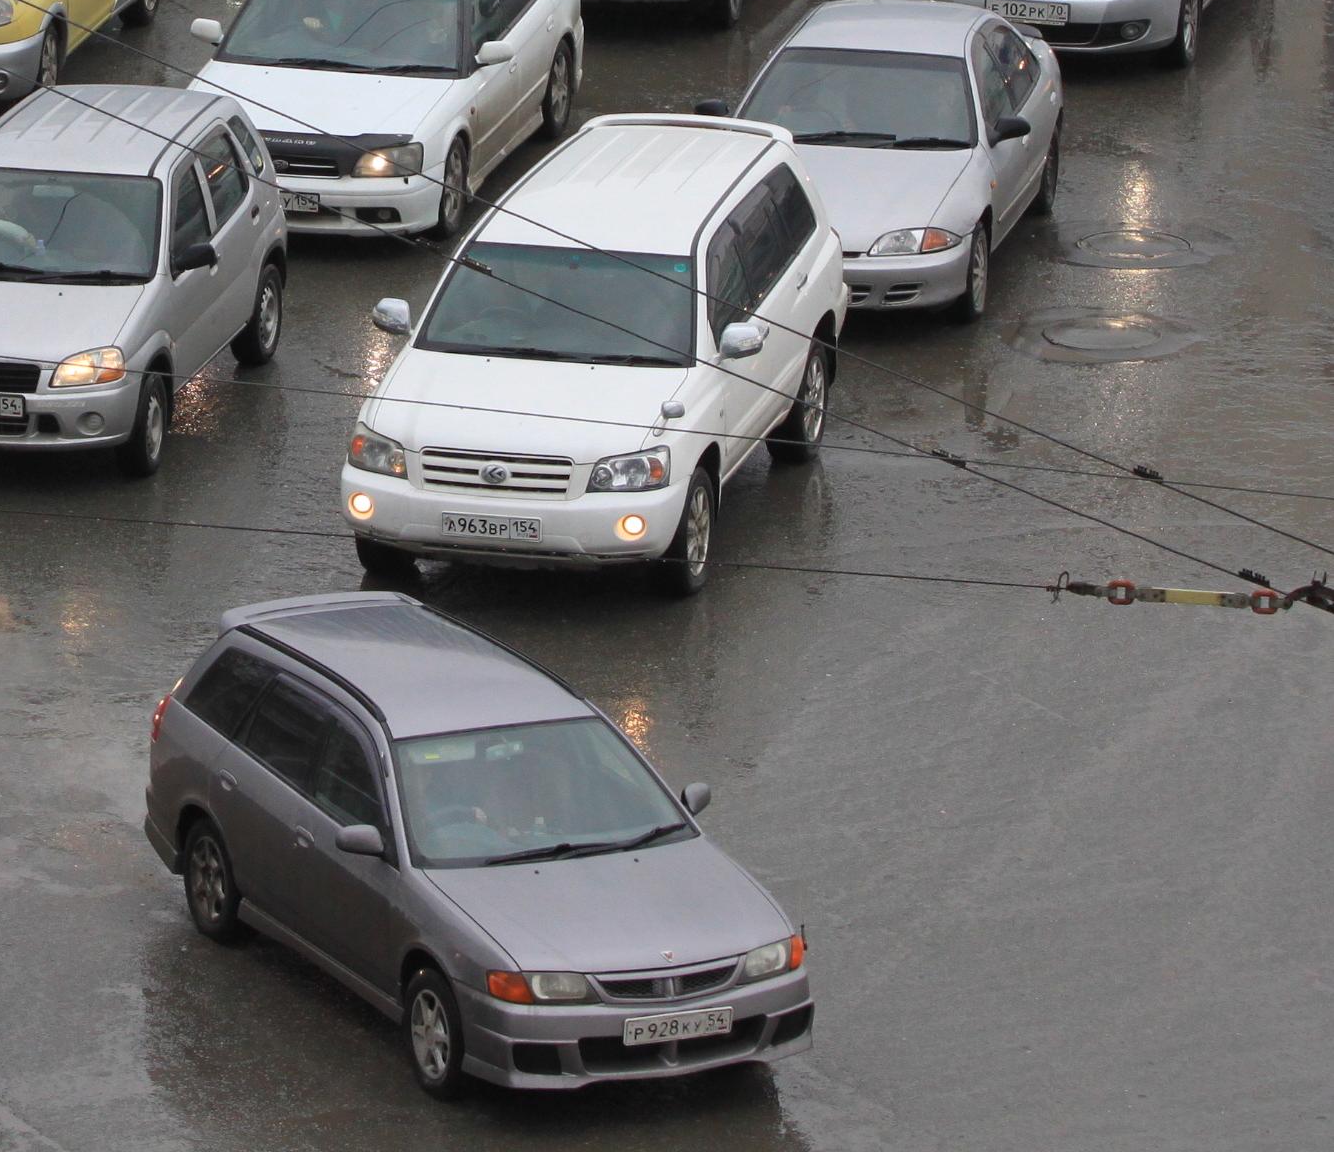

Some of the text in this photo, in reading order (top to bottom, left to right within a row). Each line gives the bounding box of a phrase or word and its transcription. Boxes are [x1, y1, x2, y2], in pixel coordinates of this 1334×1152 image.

[1049, 4, 1064, 16] 70
[1, 397, 17, 410] 54
[447, 517, 537, 536] А963ВР 154
[634, 1014, 724, 1041] Р928КУ 54
